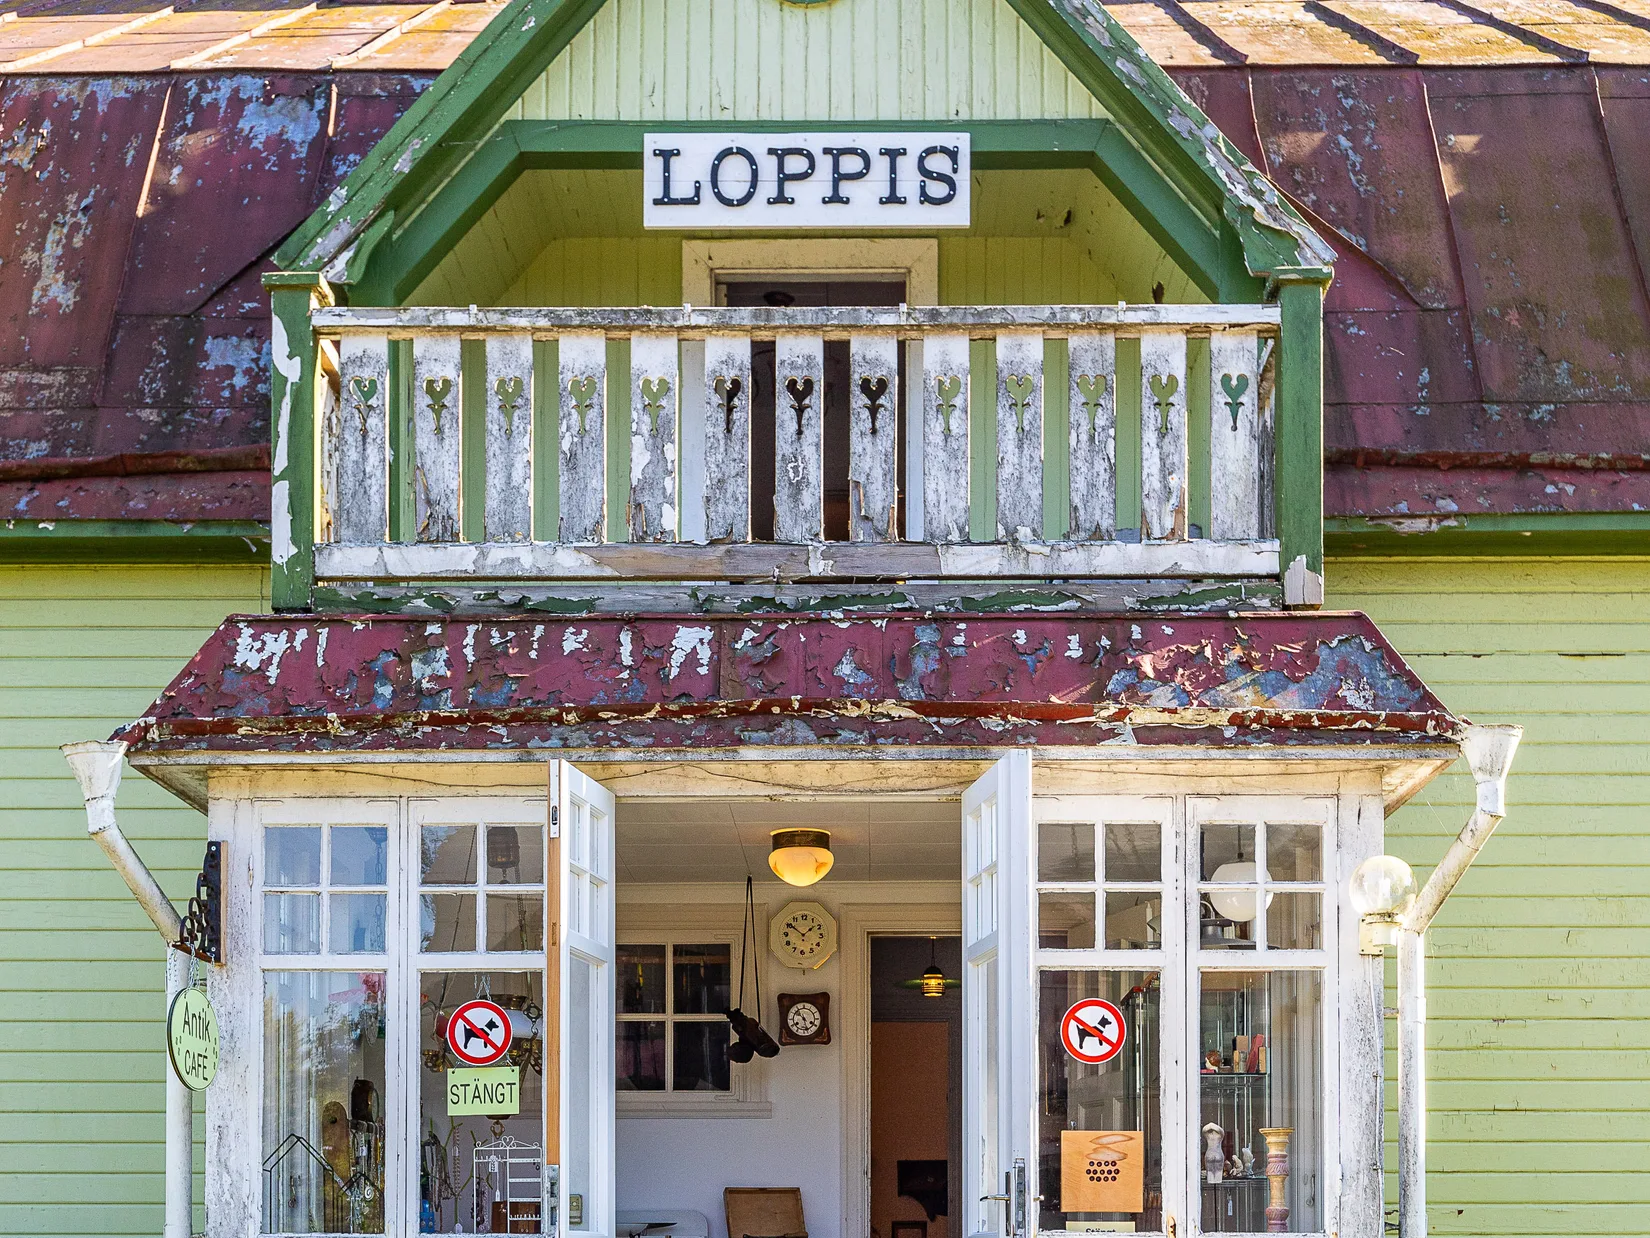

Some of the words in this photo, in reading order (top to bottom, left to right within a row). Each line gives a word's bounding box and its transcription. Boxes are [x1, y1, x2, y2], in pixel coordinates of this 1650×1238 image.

[652, 145, 959, 207] LOPPIS
[182, 1001, 211, 1043] Antik
[184, 1047, 209, 1081] CAFÉ
[450, 1078, 517, 1105] STÄNGT
